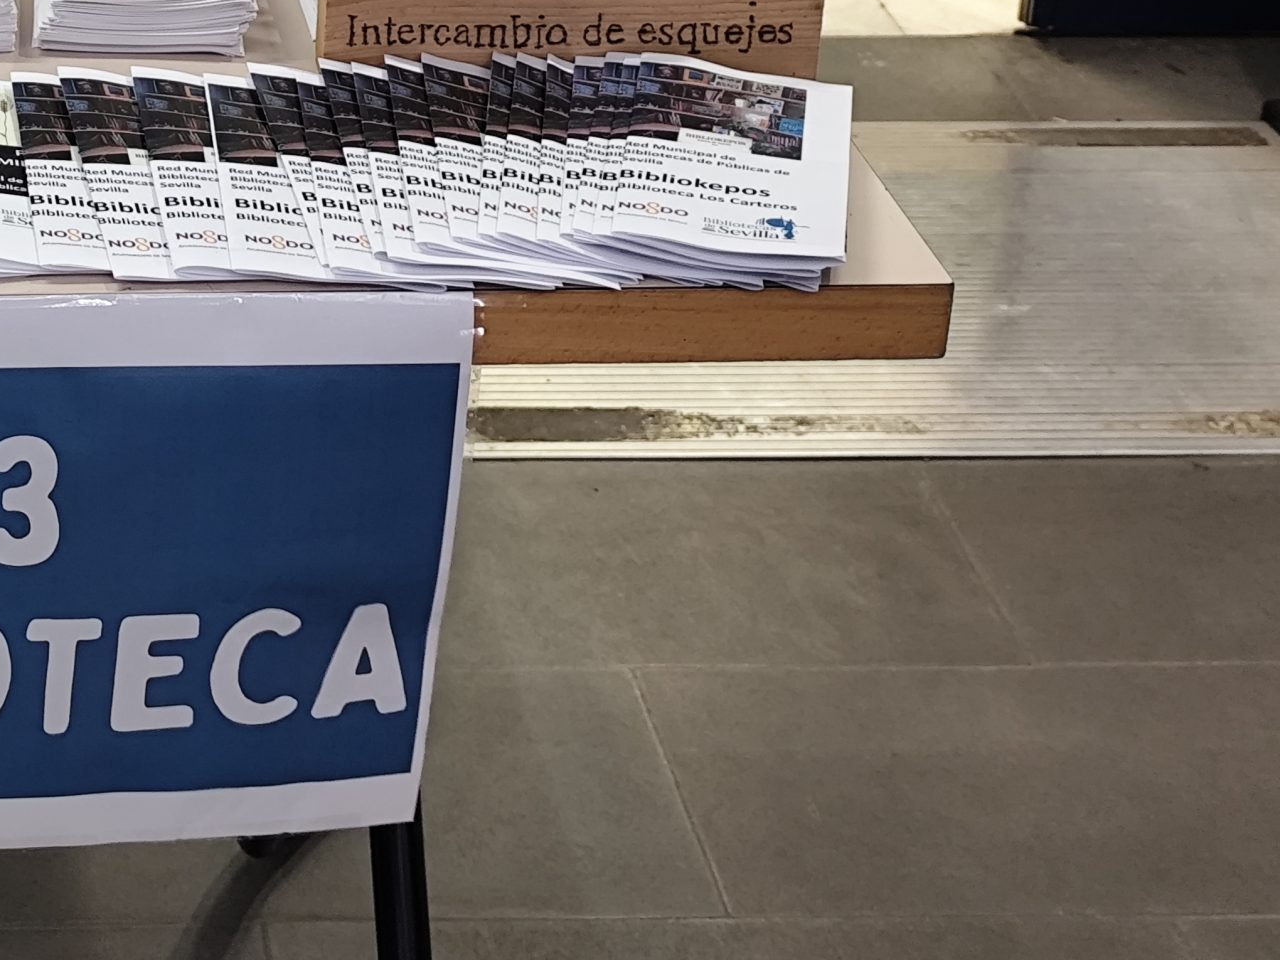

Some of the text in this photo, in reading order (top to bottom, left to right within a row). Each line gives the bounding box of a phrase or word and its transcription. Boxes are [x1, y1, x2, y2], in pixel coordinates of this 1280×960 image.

[345, 11, 794, 54] Intercambio de esquejes
[400, 146, 424, 154] Red
[653, 142, 717, 160] Municipal
[622, 156, 663, 165] Sevilla
[624, 148, 790, 176] Bibliotecas de Públicas de
[160, 181, 202, 189] Sevilla
[232, 183, 273, 193] Sevilla
[620, 169, 771, 198] Bibliokepos
[618, 182, 798, 211] Biblioteca Los Carteros
[719, 226, 780, 239] Sevilla
